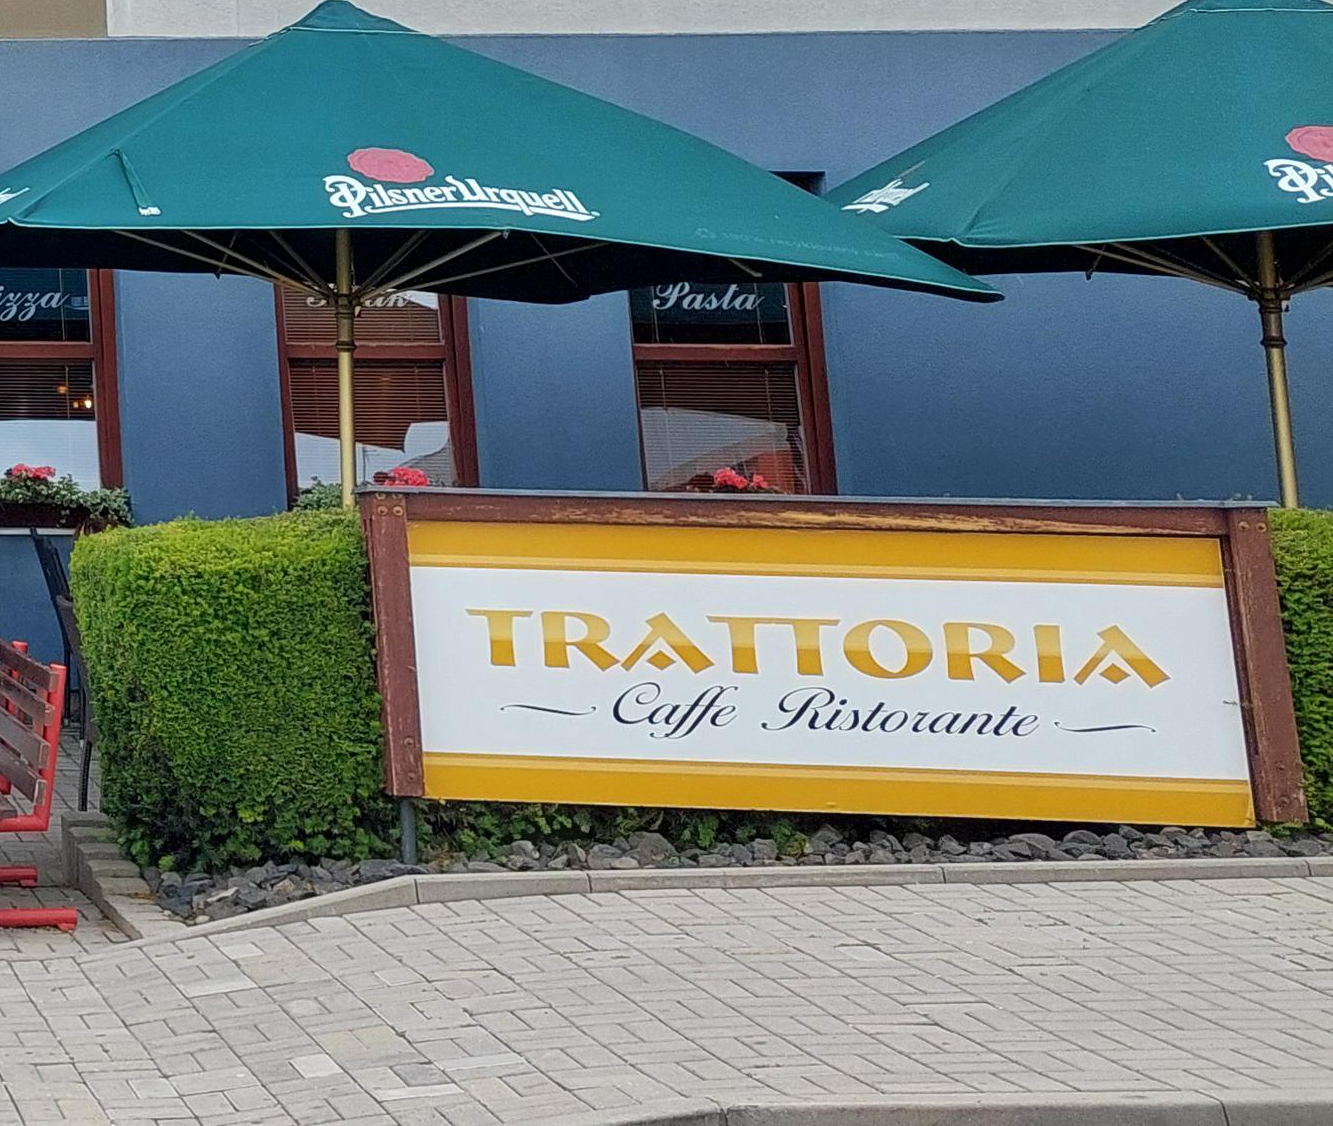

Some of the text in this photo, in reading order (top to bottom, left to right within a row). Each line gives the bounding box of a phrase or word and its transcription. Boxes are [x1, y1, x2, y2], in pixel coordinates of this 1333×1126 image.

[322, 175, 599, 218] Pilsner Urquell
[652, 281, 766, 310] Pasta
[465, 608, 1172, 689] TRATTORIA
[613, 682, 1041, 739] Caffe Ristorante
